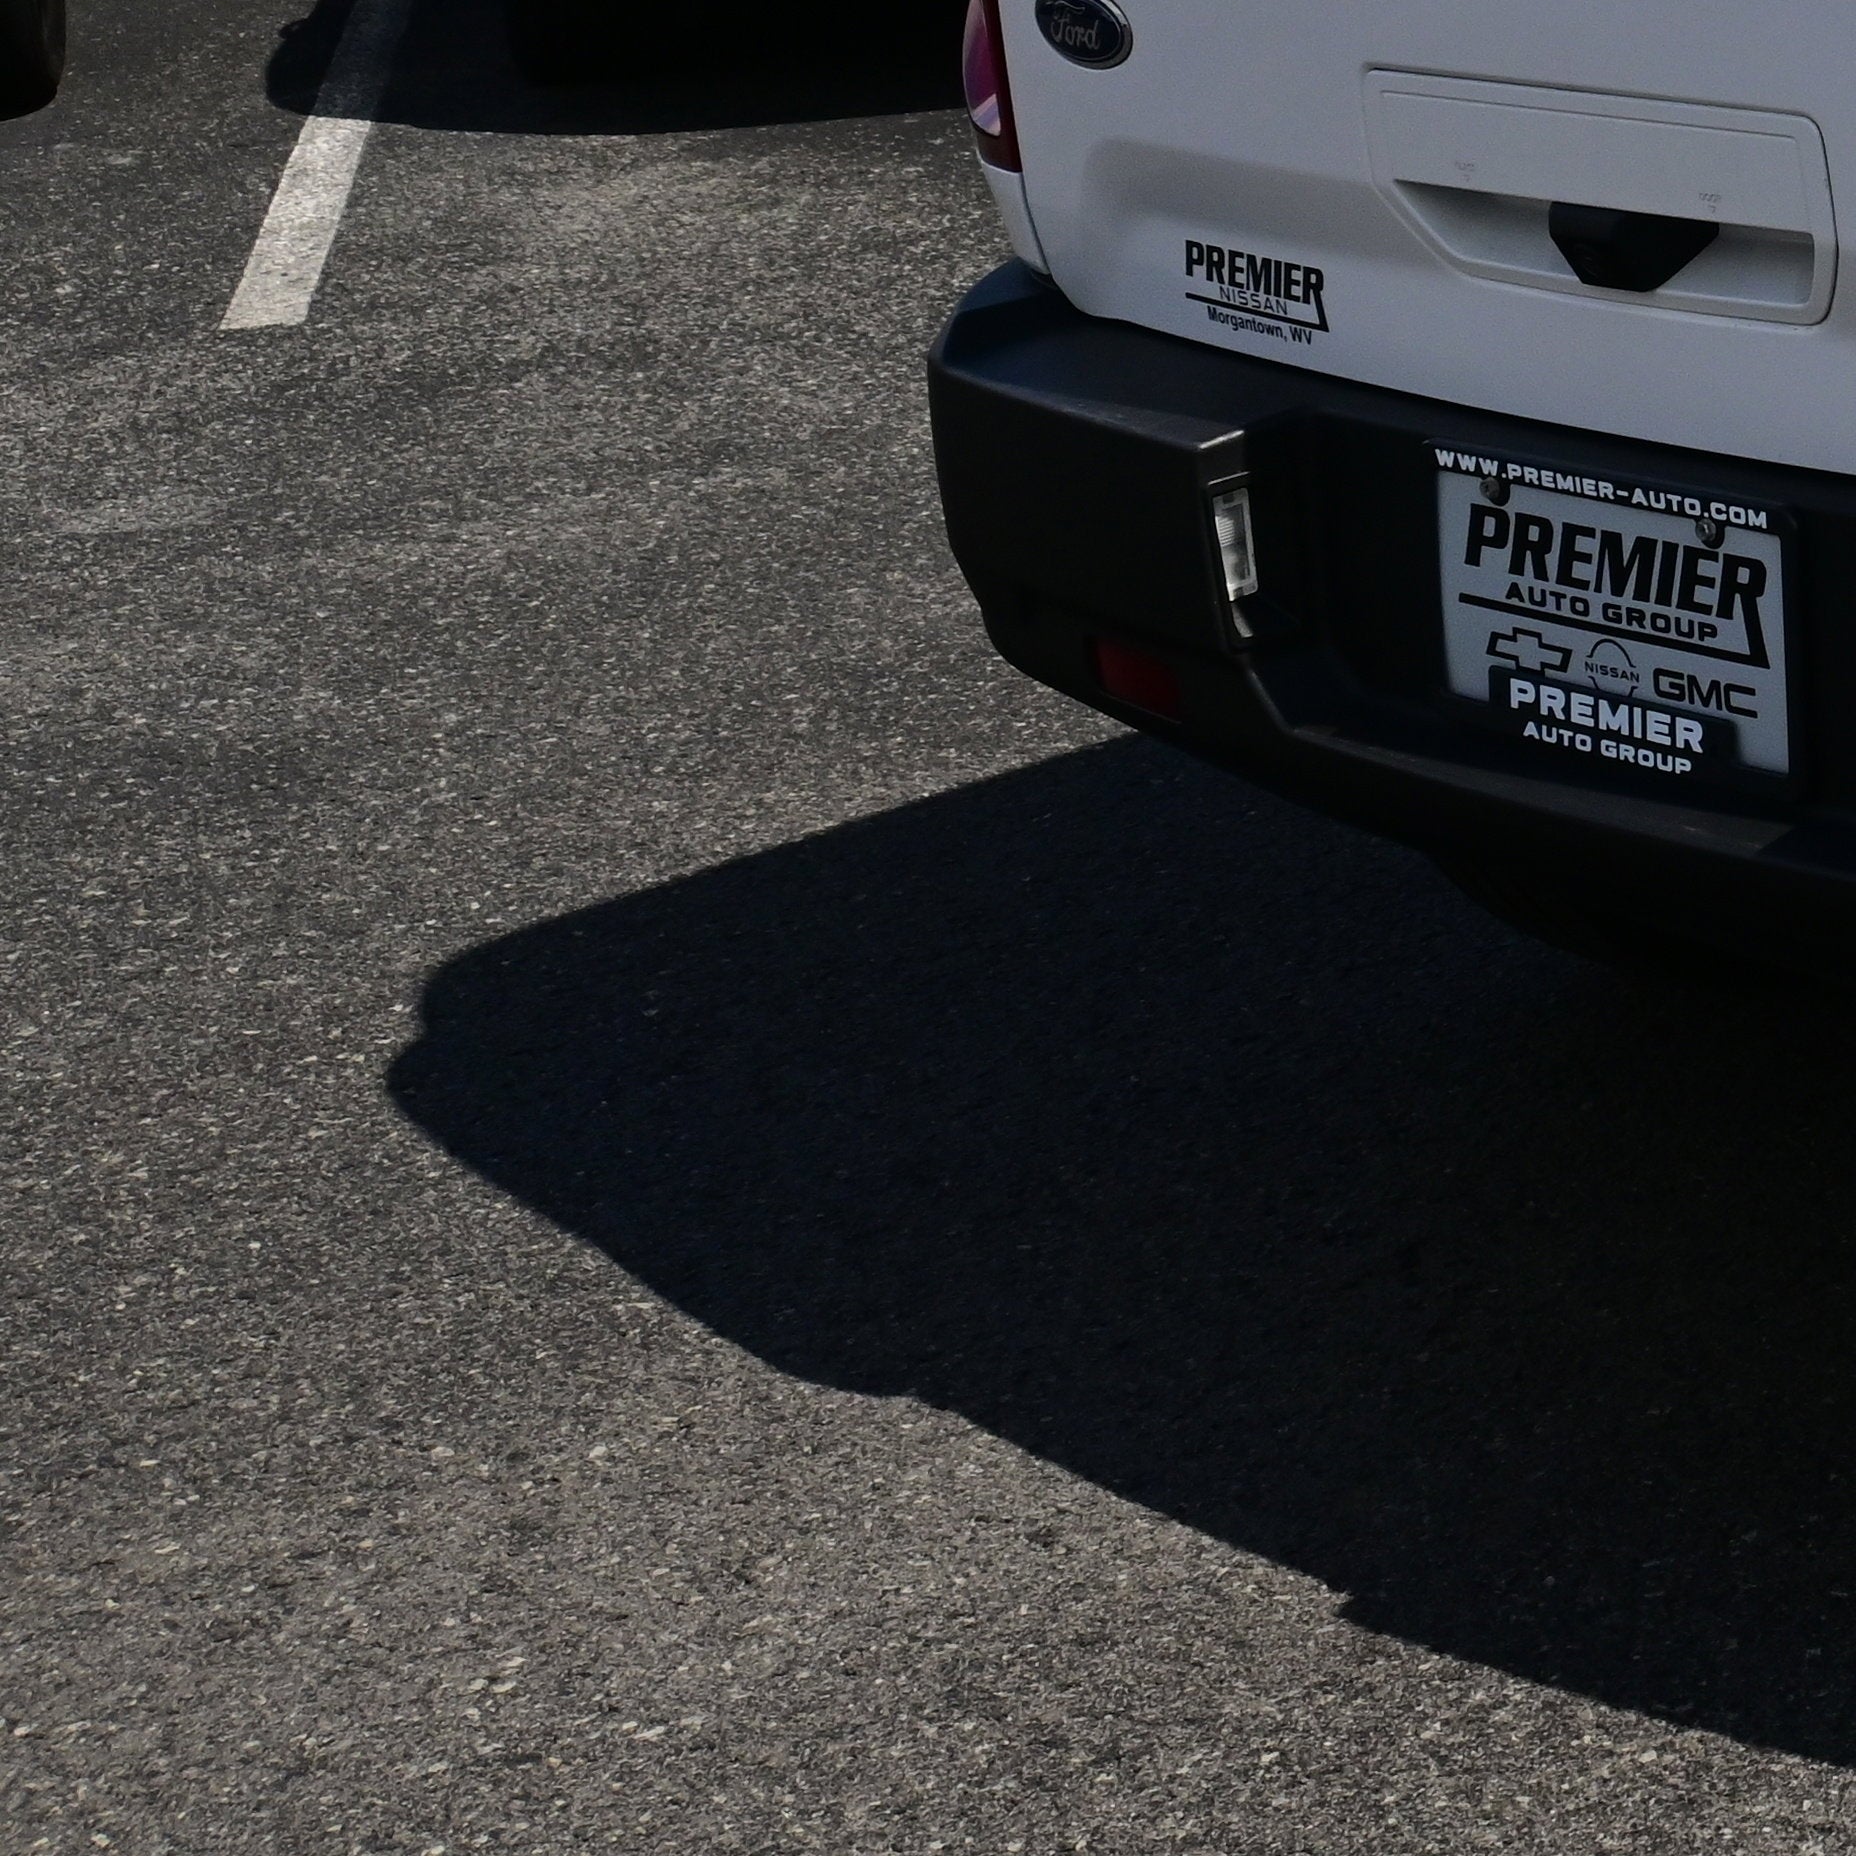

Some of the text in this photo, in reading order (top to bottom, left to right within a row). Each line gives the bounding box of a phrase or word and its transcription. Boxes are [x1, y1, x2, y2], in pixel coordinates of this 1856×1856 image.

[1049, 0, 1101, 50] Ford
[1184, 239, 1326, 309] PREMIER
[1218, 285, 1289, 315] NISSAN
[1206, 305, 1313, 345] Morgantown, WV
[1434, 448, 1767, 530] WWW.PREMIER-AUTO.COM
[1464, 502, 1768, 626] PREMIER
[1505, 581, 1718, 642] AUTO GROUP
[1584, 660, 1640, 684] NISSAN
[1652, 666, 1758, 719] GMC
[1509, 677, 1704, 753] PREMIER
[1522, 721, 1692, 774] AUTO GROUP
